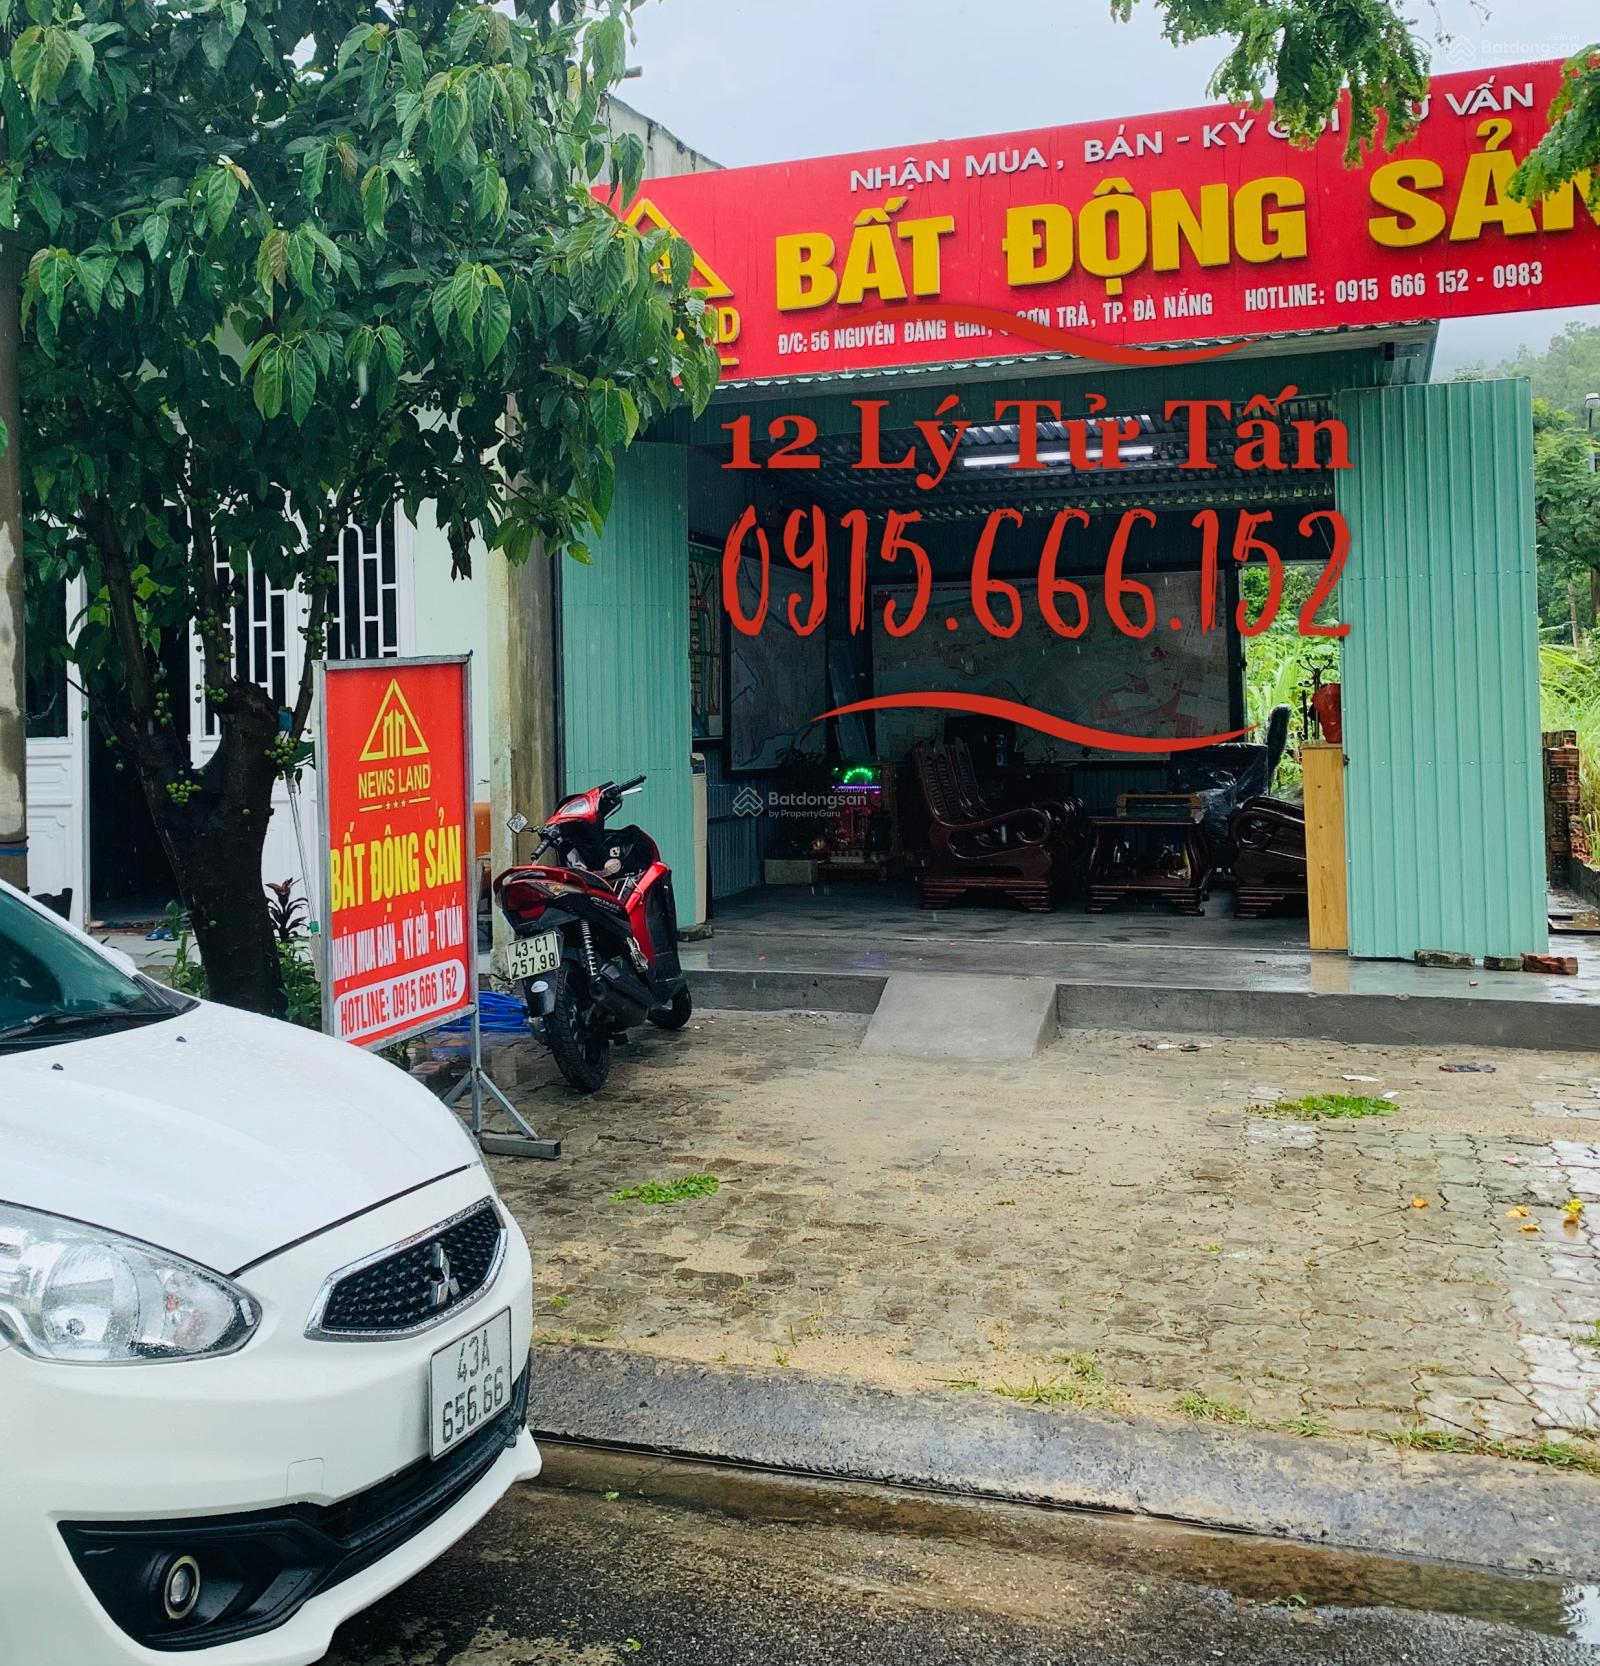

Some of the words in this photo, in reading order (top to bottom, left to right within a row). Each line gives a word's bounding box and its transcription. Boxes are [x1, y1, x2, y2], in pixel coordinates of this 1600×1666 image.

[850, 156, 950, 191] NHẬN
[1084, 123, 1163, 164] BÁN
[1202, 108, 1256, 148] KÝ
[1444, 75, 1534, 116] VẤN
[776, 196, 955, 312] BẤT
[1001, 177, 1307, 297] ĐỘNG
[904, 318, 947, 343] ĐĂNG
[1056, 301, 1097, 329] TRÀ,
[1103, 301, 1127, 324] TP.
[1133, 294, 1157, 322] ĐÀ
[1163, 287, 1214, 319] NẴNG
[1245, 282, 1325, 312] HOTLINE:
[1335, 278, 1378, 304] 0915
[1390, 272, 1426, 299] 666
[1436, 268, 1469, 295] 152
[1492, 261, 1543, 289] 0983
[358, 768, 395, 800] NEWS
[398, 763, 431, 793] LAND
[330, 821, 366, 912] BẤT
[370, 824, 420, 912] ĐỘNG
[424, 806, 462, 889] SẢN
[332, 926, 356, 988] NHẬN
[356, 928, 377, 975] MUA
[377, 915, 397, 969] BÁN
[402, 909, 415, 960] KÝ
[415, 900, 430, 957] GỬI
[435, 905, 446, 951] TƯ
[446, 891, 464, 947] VẤN
[511, 952, 556, 979] 257.98
[515, 936, 549, 959] 43-C1
[340, 988, 390, 1037] HOTLINE:
[392, 979, 417, 1018] 0915
[419, 971, 438, 1009] 666
[440, 965, 457, 1001] 152
[457, 1329, 490, 1383] 43A
[442, 1365, 504, 1444] 656.66
